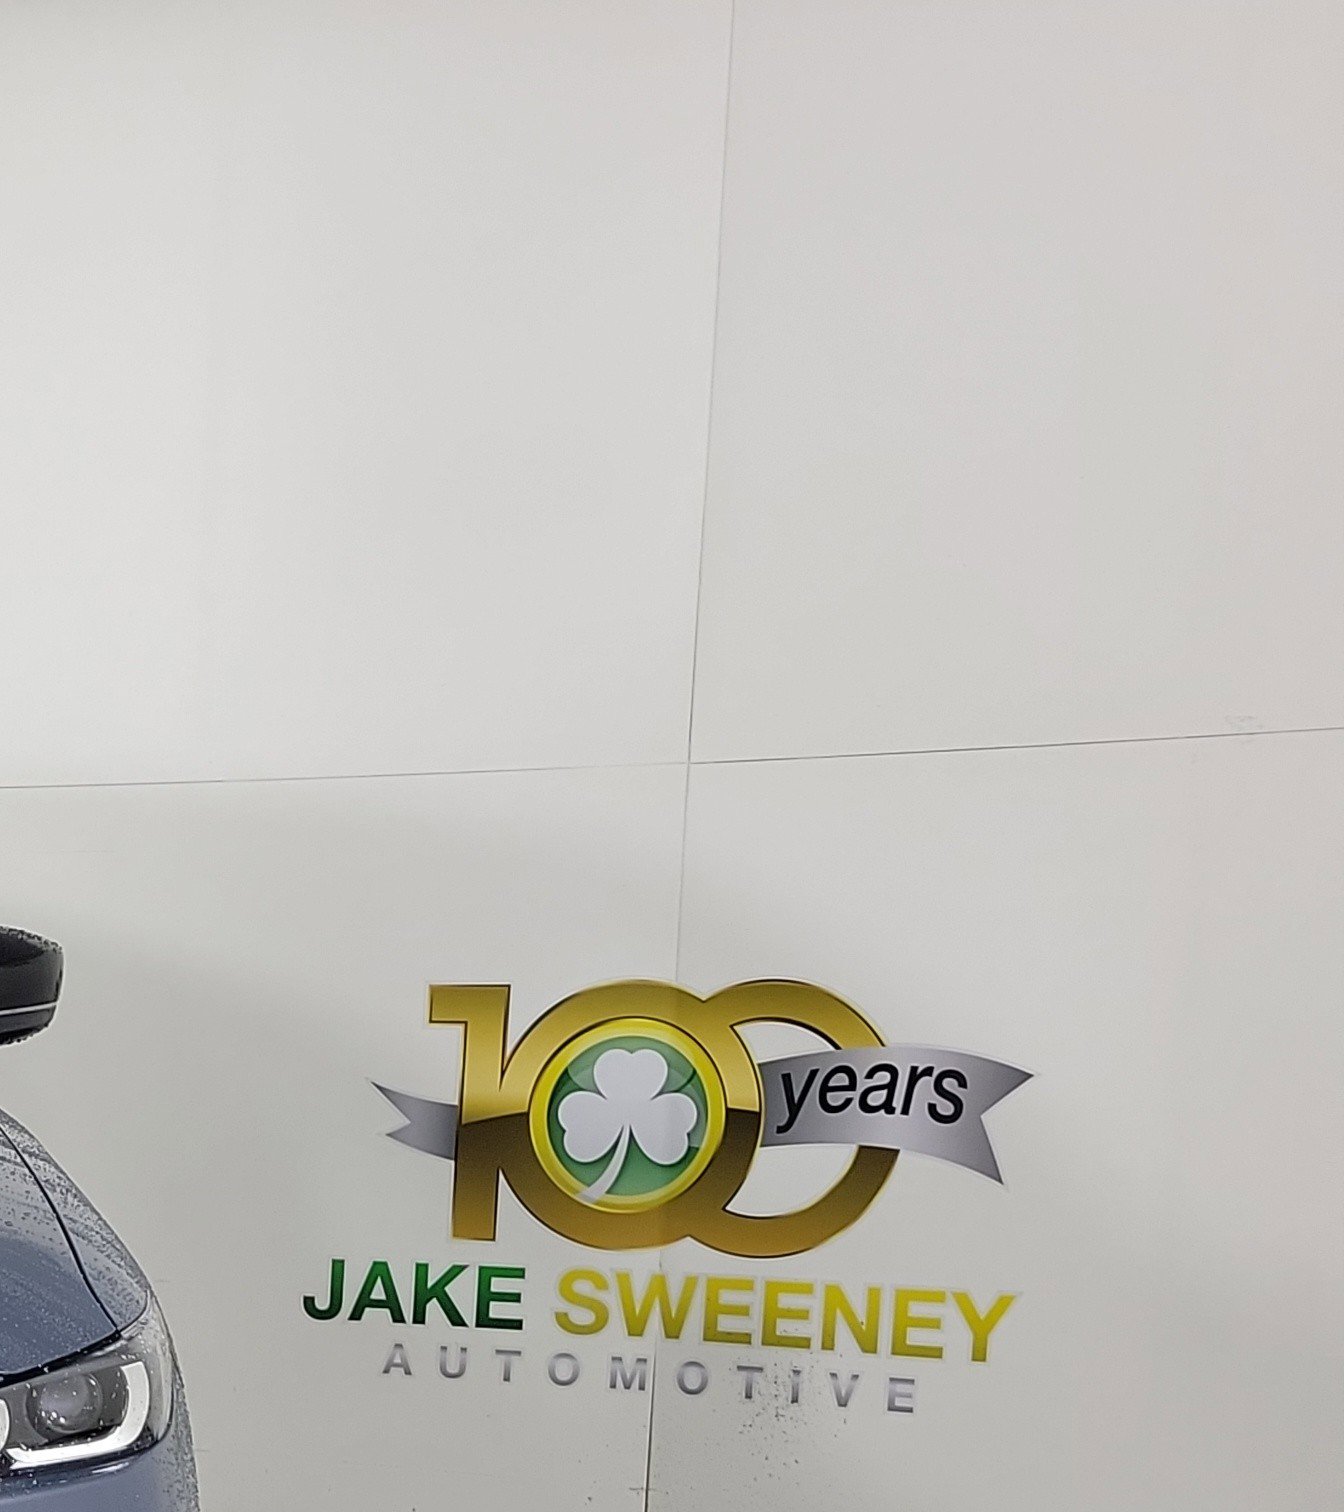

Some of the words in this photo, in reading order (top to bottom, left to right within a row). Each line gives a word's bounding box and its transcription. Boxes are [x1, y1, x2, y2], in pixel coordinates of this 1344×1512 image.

[428, 979, 901, 1259] 100
[775, 1061, 968, 1136] years
[302, 1258, 527, 1331] JAKE
[554, 1268, 1016, 1363] SWEENEY
[382, 1342, 915, 1414] AUTOMOTIVE
